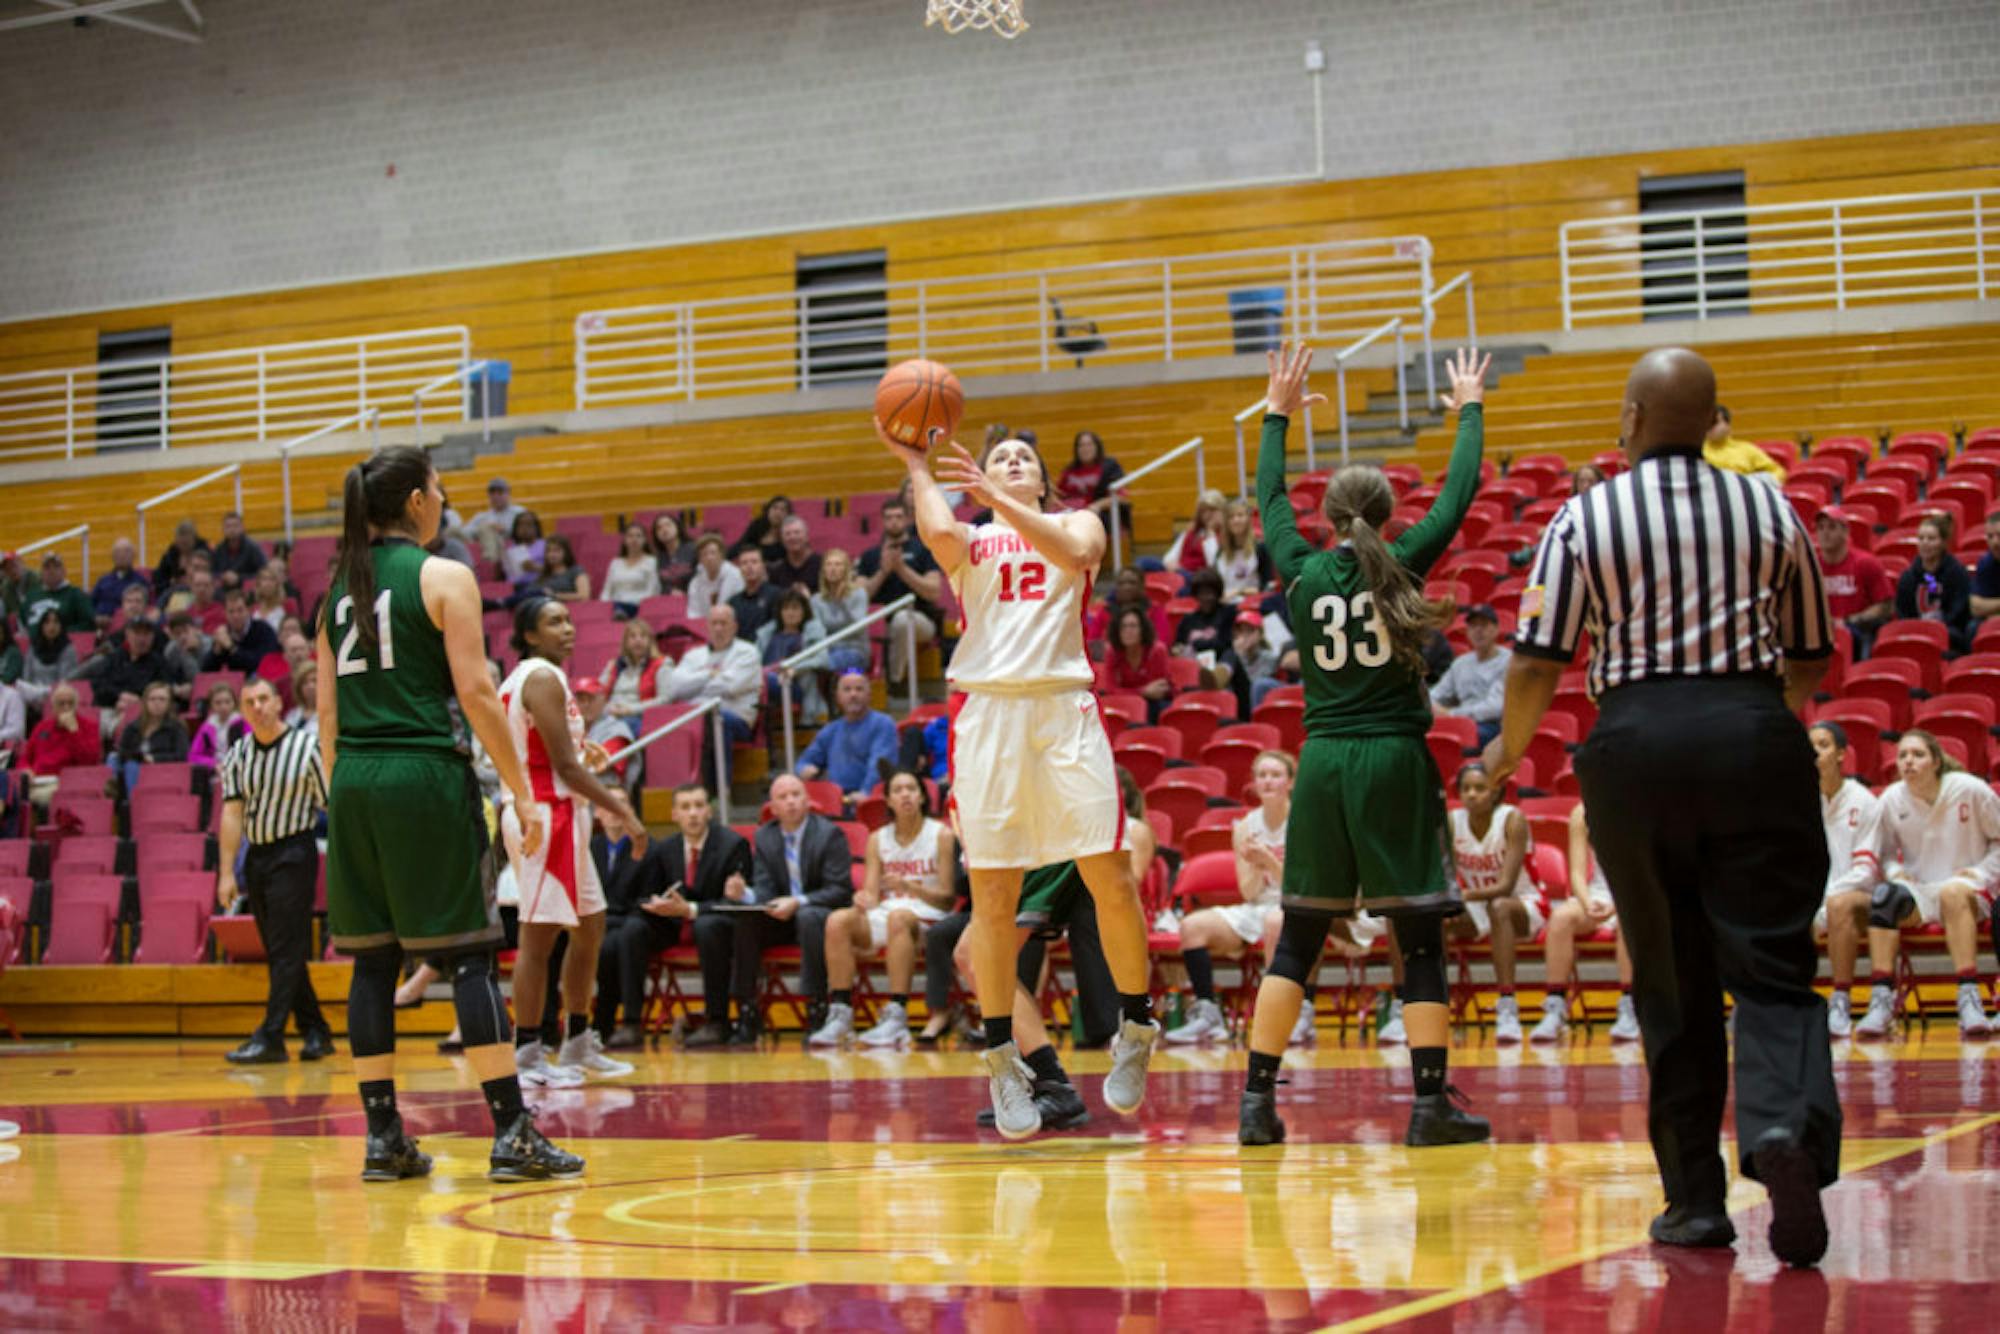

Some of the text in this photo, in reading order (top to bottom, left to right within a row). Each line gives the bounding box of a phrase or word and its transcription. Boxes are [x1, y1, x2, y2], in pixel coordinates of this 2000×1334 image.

[998, 562, 1046, 602] 12
[335, 589, 395, 676] 21
[1312, 591, 1392, 671] 33
[1959, 803, 1969, 823] C
